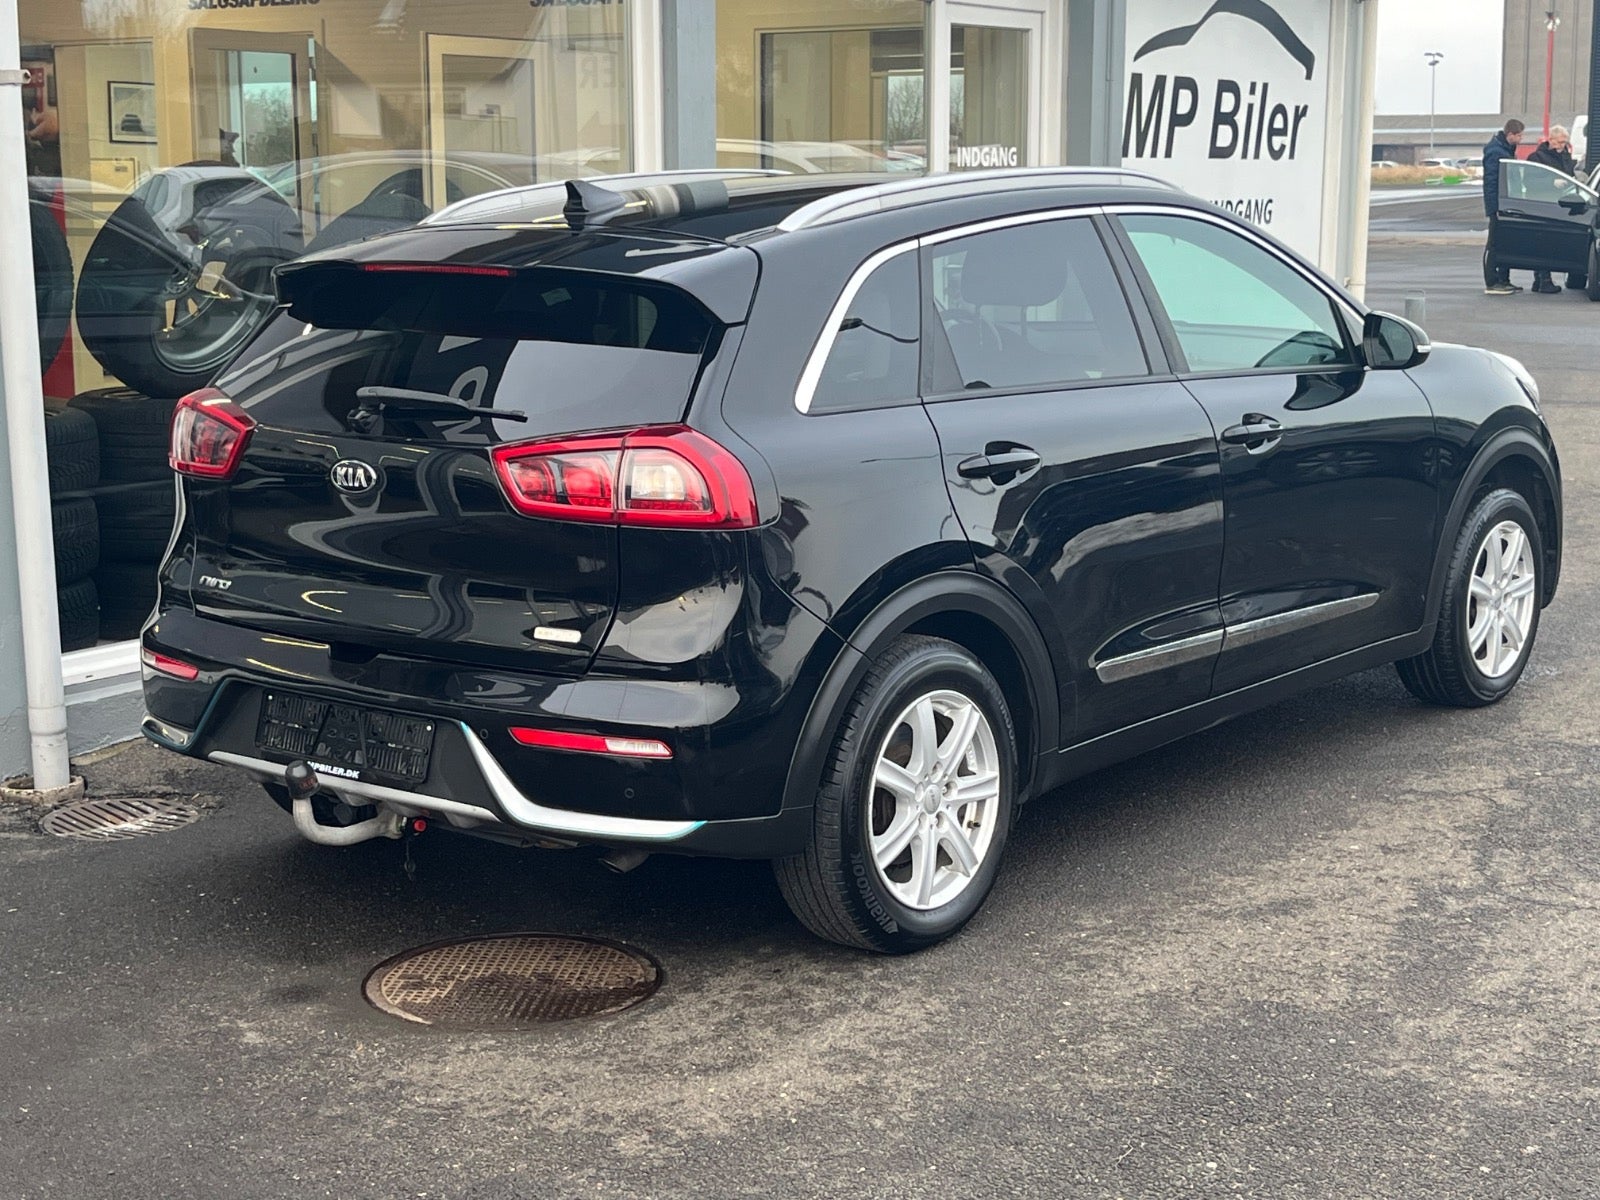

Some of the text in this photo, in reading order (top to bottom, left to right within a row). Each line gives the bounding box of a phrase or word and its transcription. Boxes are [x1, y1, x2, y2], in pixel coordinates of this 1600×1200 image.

[1122, 72, 1309, 161] MP Biler
[957, 146, 1017, 167] INDGANG
[1210, 198, 1273, 224] GANG
[336, 466, 368, 488] KIA
